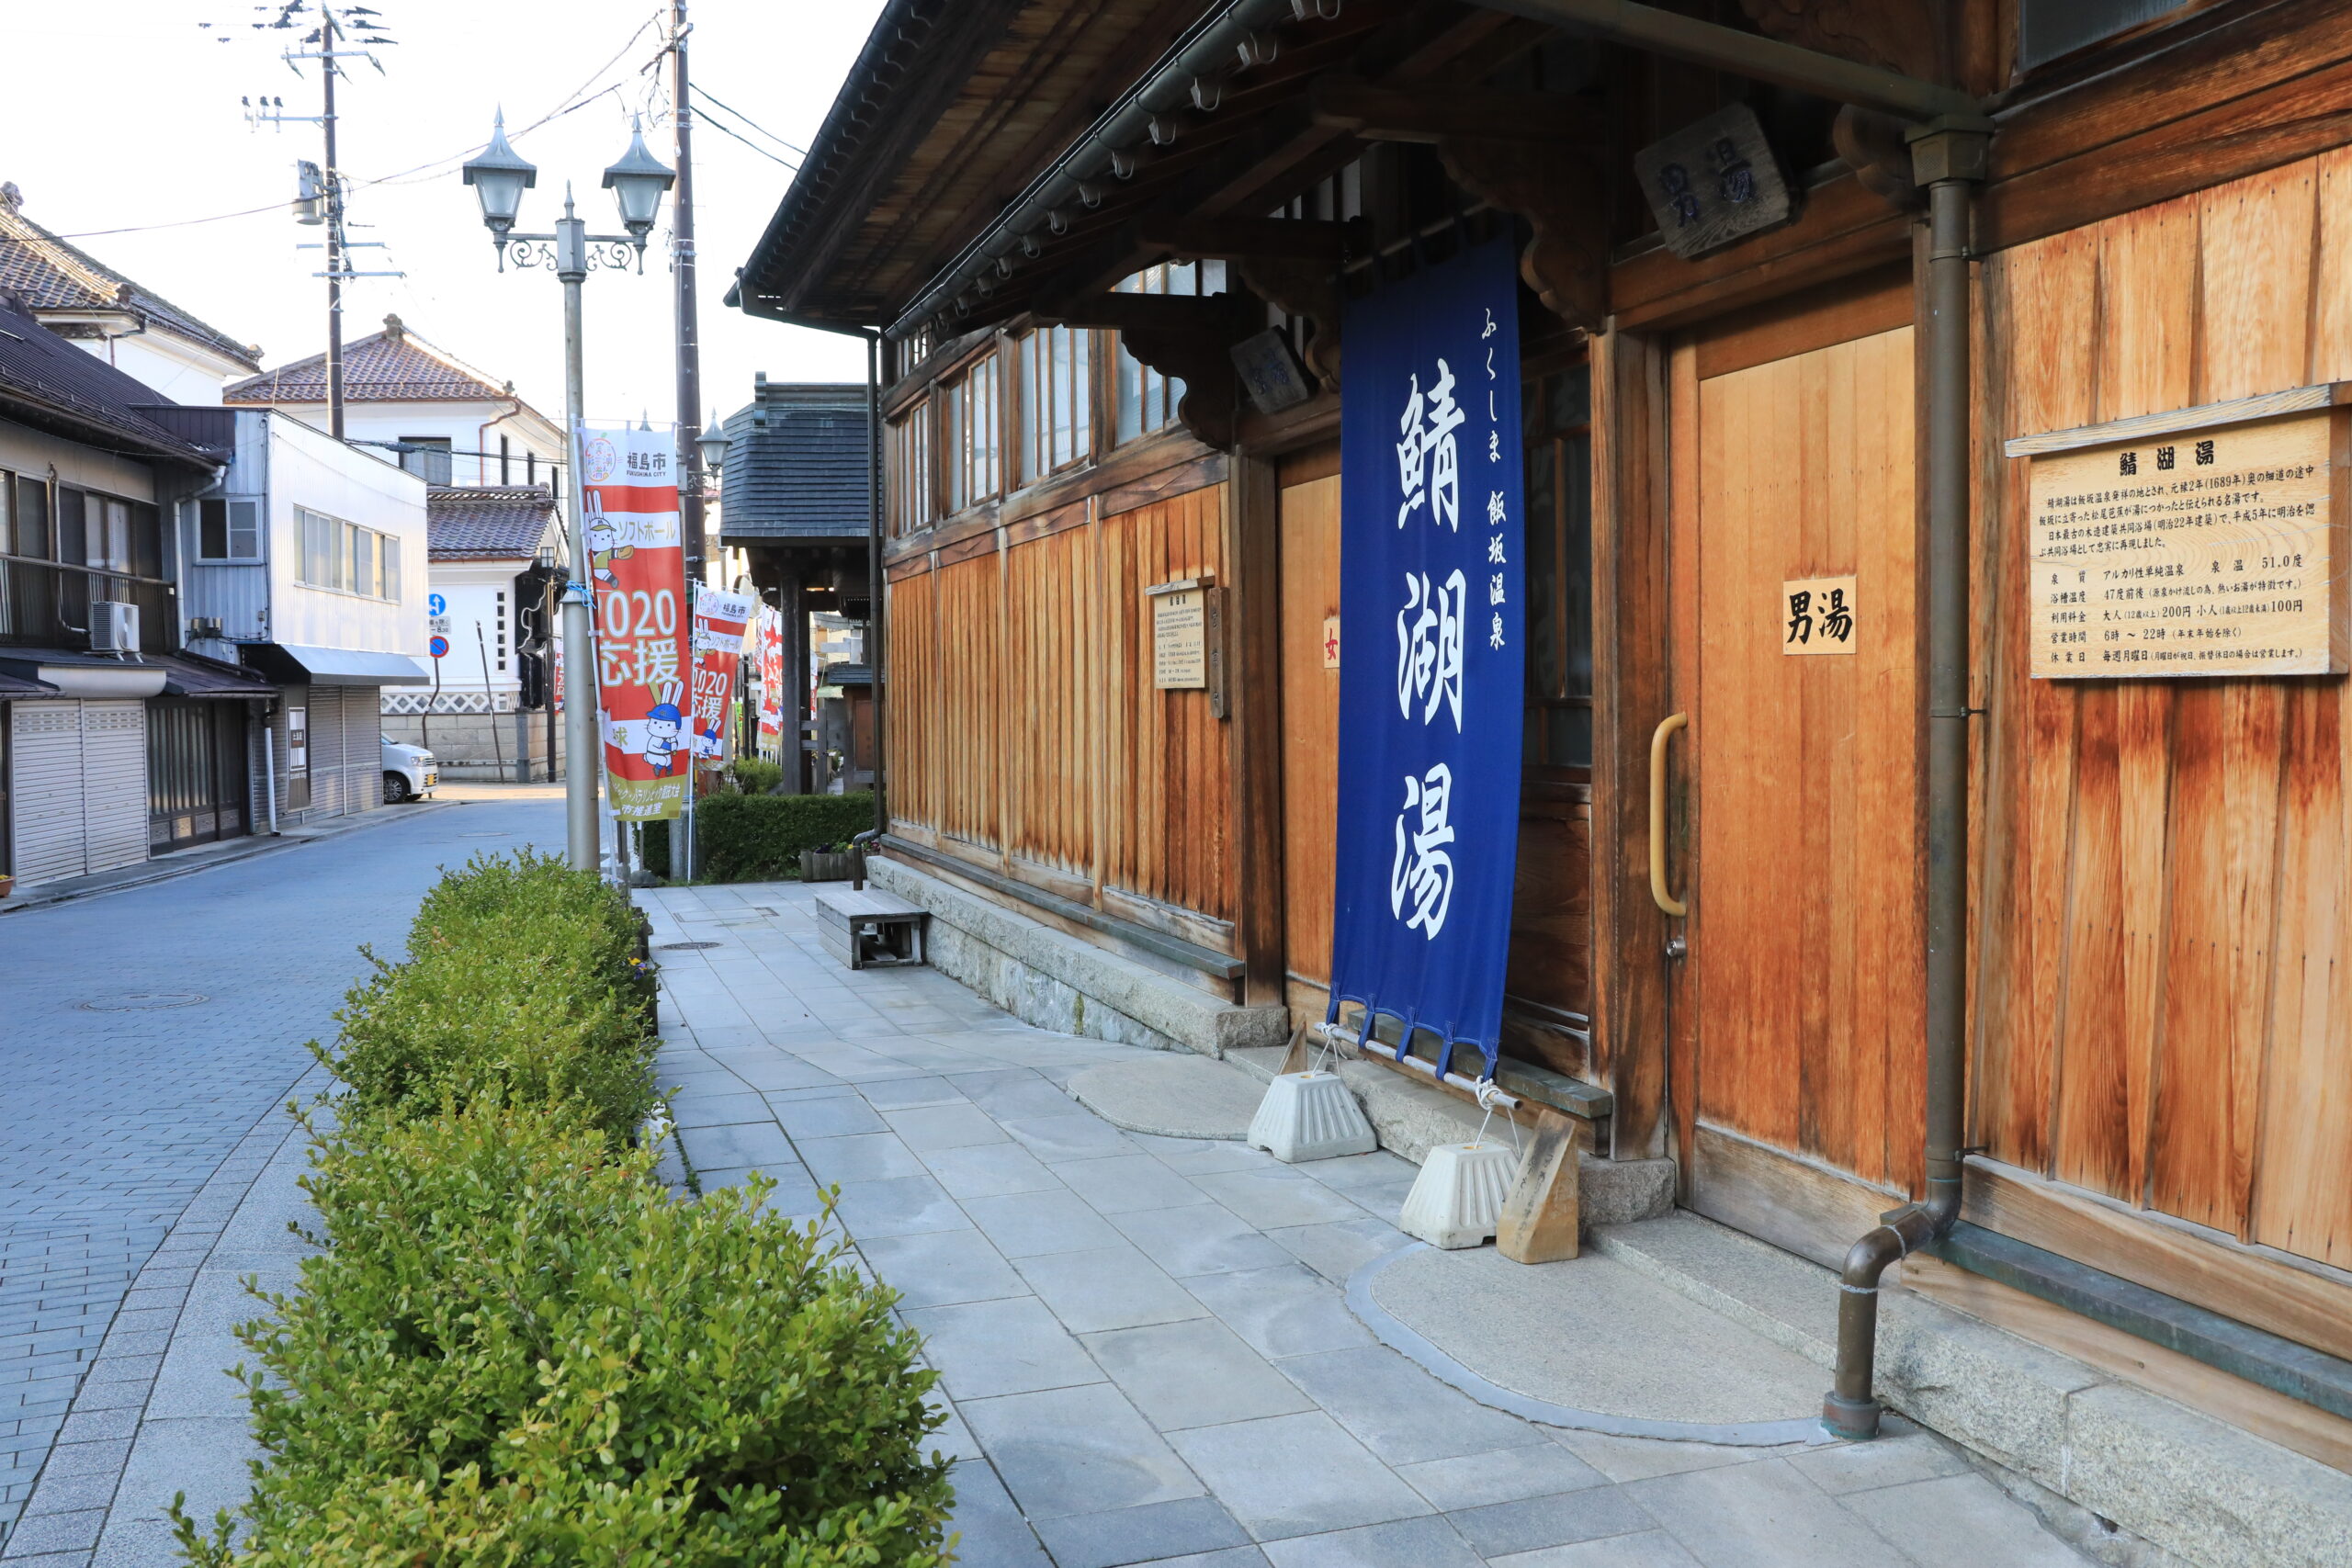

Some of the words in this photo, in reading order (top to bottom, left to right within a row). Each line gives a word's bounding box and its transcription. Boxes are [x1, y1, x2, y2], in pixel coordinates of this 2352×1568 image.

[1481, 308, 1501, 463] ふくしま
[627, 452, 667, 470] 福島市
[2120, 439, 2214, 477] 鯖湖湯
[618, 521, 676, 542] ソフトボール
[2039, 536, 2166, 558] ぶ共同浴場として忠実に再現しました。
[1487, 490, 1507, 651] 飯坂温泉
[2103, 563, 2185, 580] アルカリ性単純温泉
[2262, 554, 2303, 569] 51.0度
[722, 603, 747, 615] 福島市
[2050, 591, 2086, 604] 浴槽温度
[1786, 588, 1853, 645] 男湯
[2051, 611, 2086, 624] 利用料金
[1325, 627, 1339, 660] 女
[1391, 358, 1466, 941] 鯖湖湯
[2050, 631, 2086, 644] 営業時間
[599, 637, 681, 687] 応援
